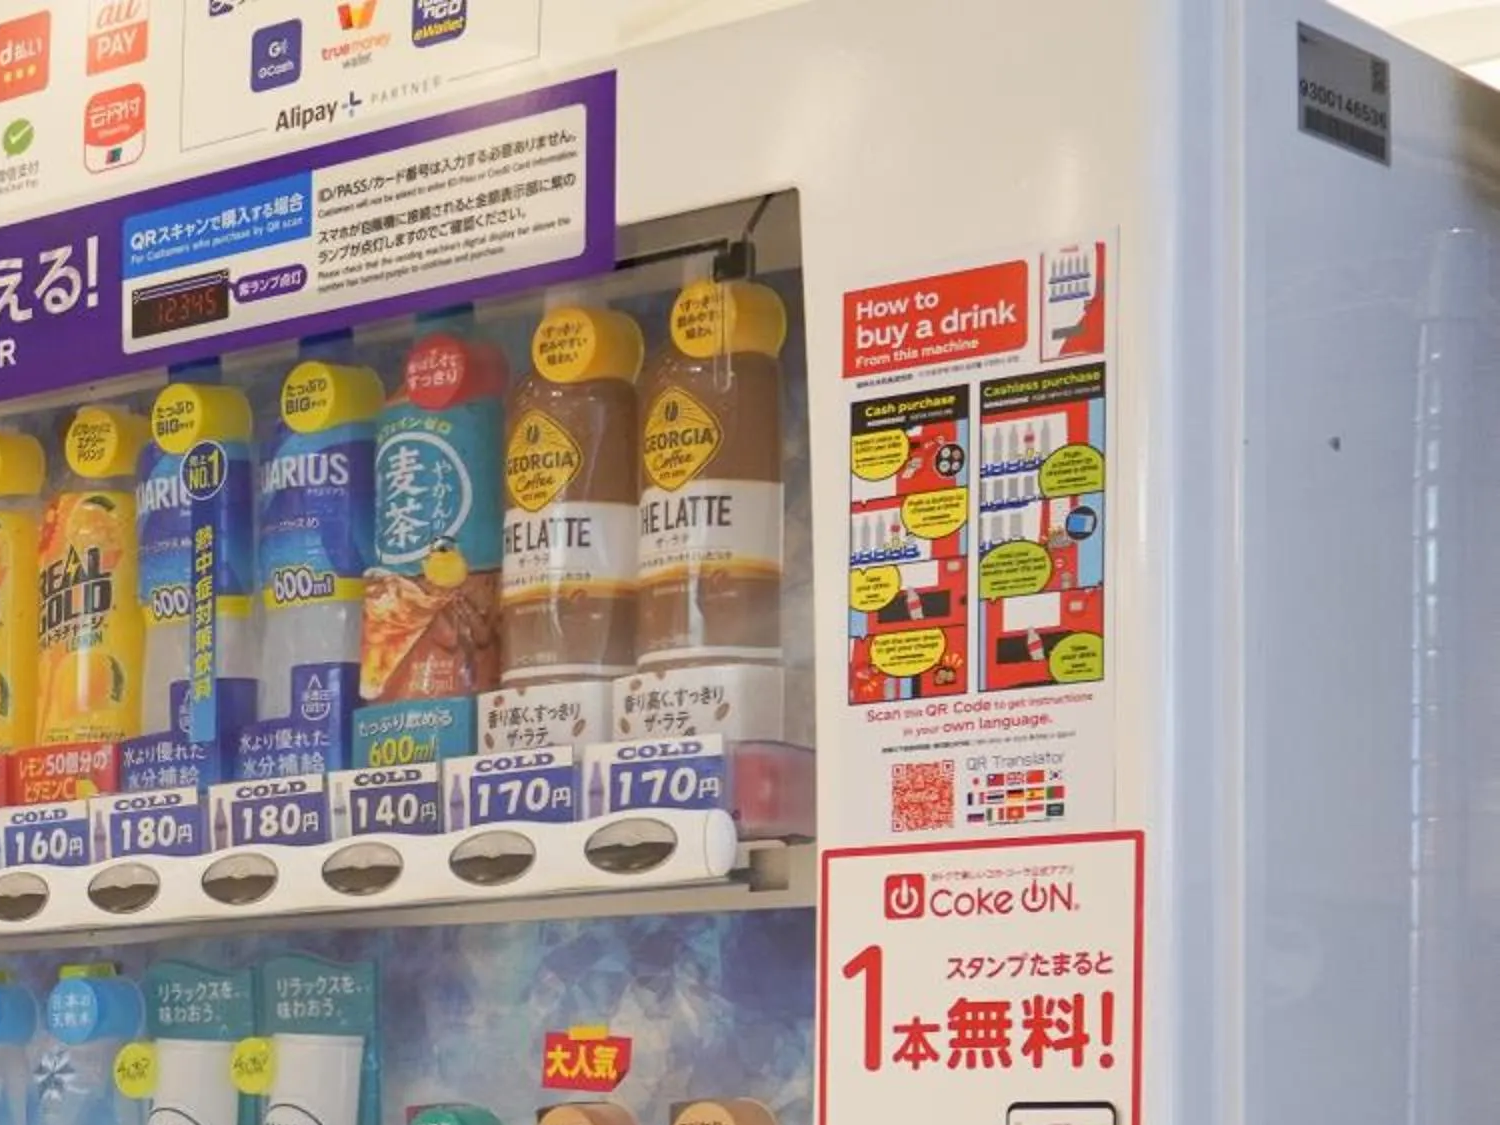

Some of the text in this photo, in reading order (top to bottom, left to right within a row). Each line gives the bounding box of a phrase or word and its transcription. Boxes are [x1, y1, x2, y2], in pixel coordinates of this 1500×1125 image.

[274, 98, 339, 132] Alipay
[855, 291, 940, 321] How to
[856, 299, 1018, 350] buy a drink
[856, 338, 980, 369] From this machine
[865, 402, 896, 418] Cash
[897, 395, 957, 415] purchase
[386, 446, 431, 549] 麦茶
[274, 565, 336, 601] 600ml
[867, 708, 902, 724] Scan
[925, 703, 948, 718] QR
[952, 700, 992, 714] Code
[1027, 692, 1094, 709] instructions
[942, 720, 975, 734] own
[979, 712, 1054, 731] language.
[123, 742, 208, 766] 水より優れた
[238, 729, 333, 752] 水より優れた
[242, 751, 326, 778] 水分補給
[965, 751, 1067, 772] QR Translator
[235, 780, 308, 800] COLD
[476, 776, 573, 819] 170円
[617, 766, 721, 807] 170円
[241, 803, 320, 840] 180円
[356, 793, 438, 829] 140円
[14, 828, 84, 861] 160円
[120, 815, 194, 851] 180円
[929, 879, 1074, 917] Coke ON
[946, 950, 1114, 979] スタンプたまると
[842, 944, 1115, 1073] 1本無料!
[546, 1045, 621, 1082] 大人気
